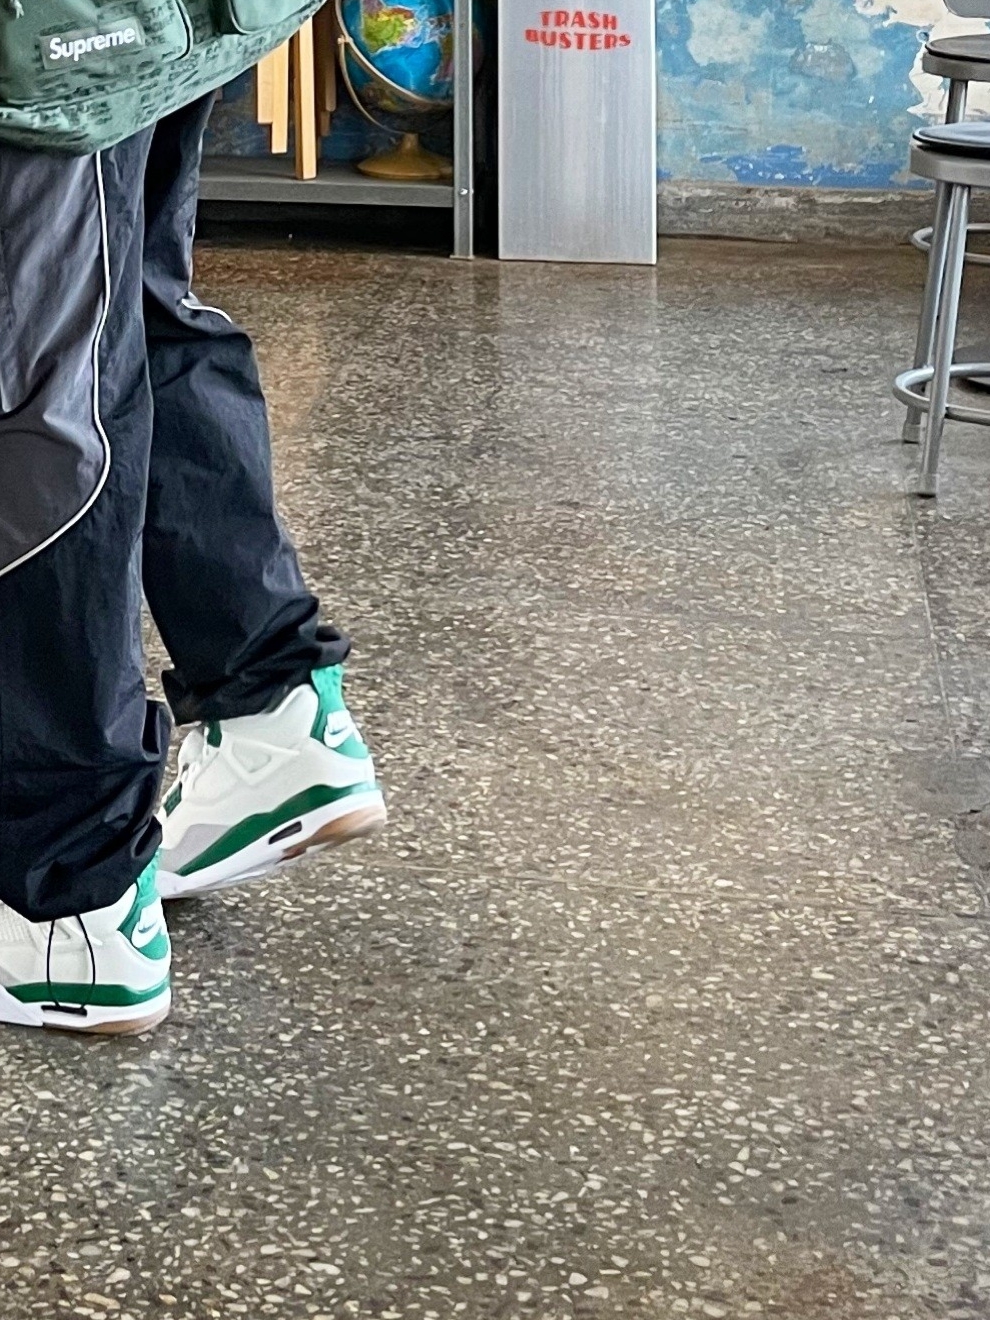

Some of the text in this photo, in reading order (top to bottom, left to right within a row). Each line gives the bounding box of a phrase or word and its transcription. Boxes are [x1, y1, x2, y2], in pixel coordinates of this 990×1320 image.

[540, 10, 618, 30] TRASH
[48, 27, 137, 62] Supreme
[524, 28, 632, 51] BUSTERS
